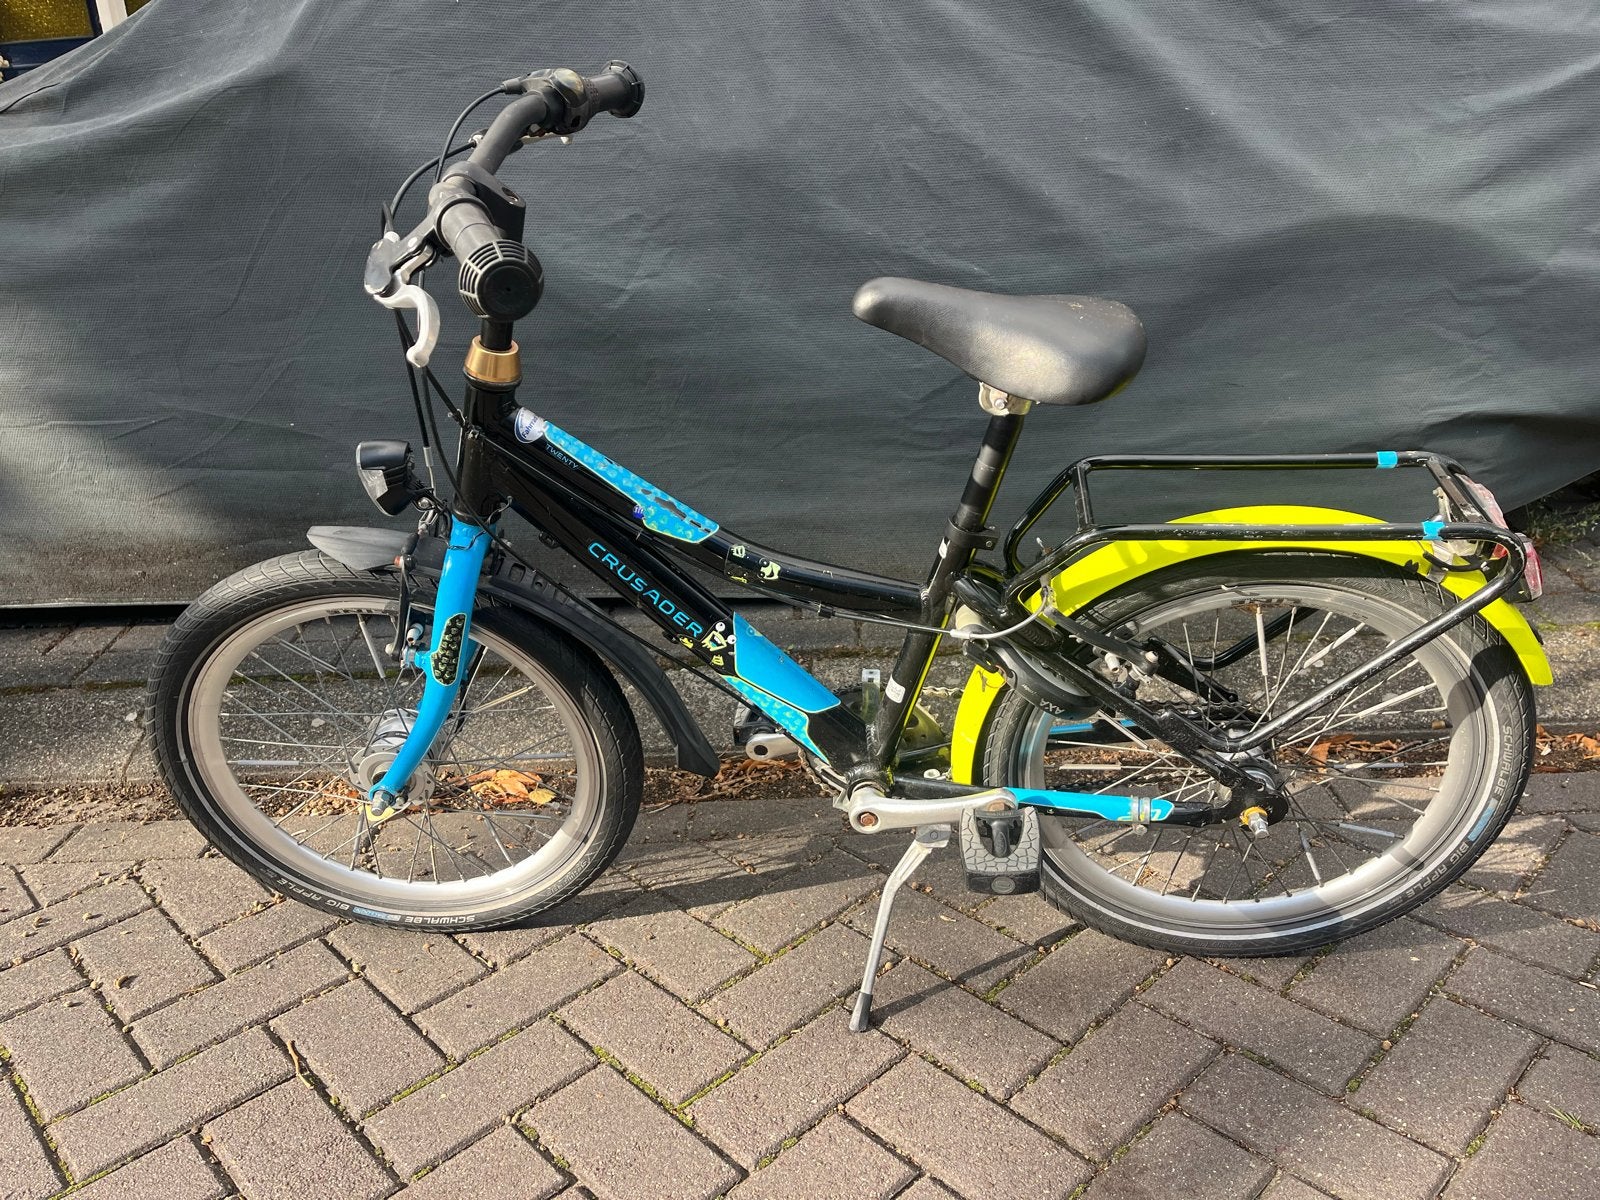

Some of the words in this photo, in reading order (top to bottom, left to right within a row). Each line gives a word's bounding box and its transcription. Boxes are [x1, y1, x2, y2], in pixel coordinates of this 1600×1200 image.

[545, 443, 579, 469] TWENTY
[588, 542, 703, 638] CRUSADER
[1040, 698, 1065, 714] AXA
[1494, 725, 1513, 796] SCHWALBE
[1449, 841, 1470, 865] BIG
[277, 877, 322, 901] APPLE
[1405, 863, 1448, 898] APPLE
[325, 899, 350, 911] BIG
[405, 914, 476, 924] SCHWALBE
